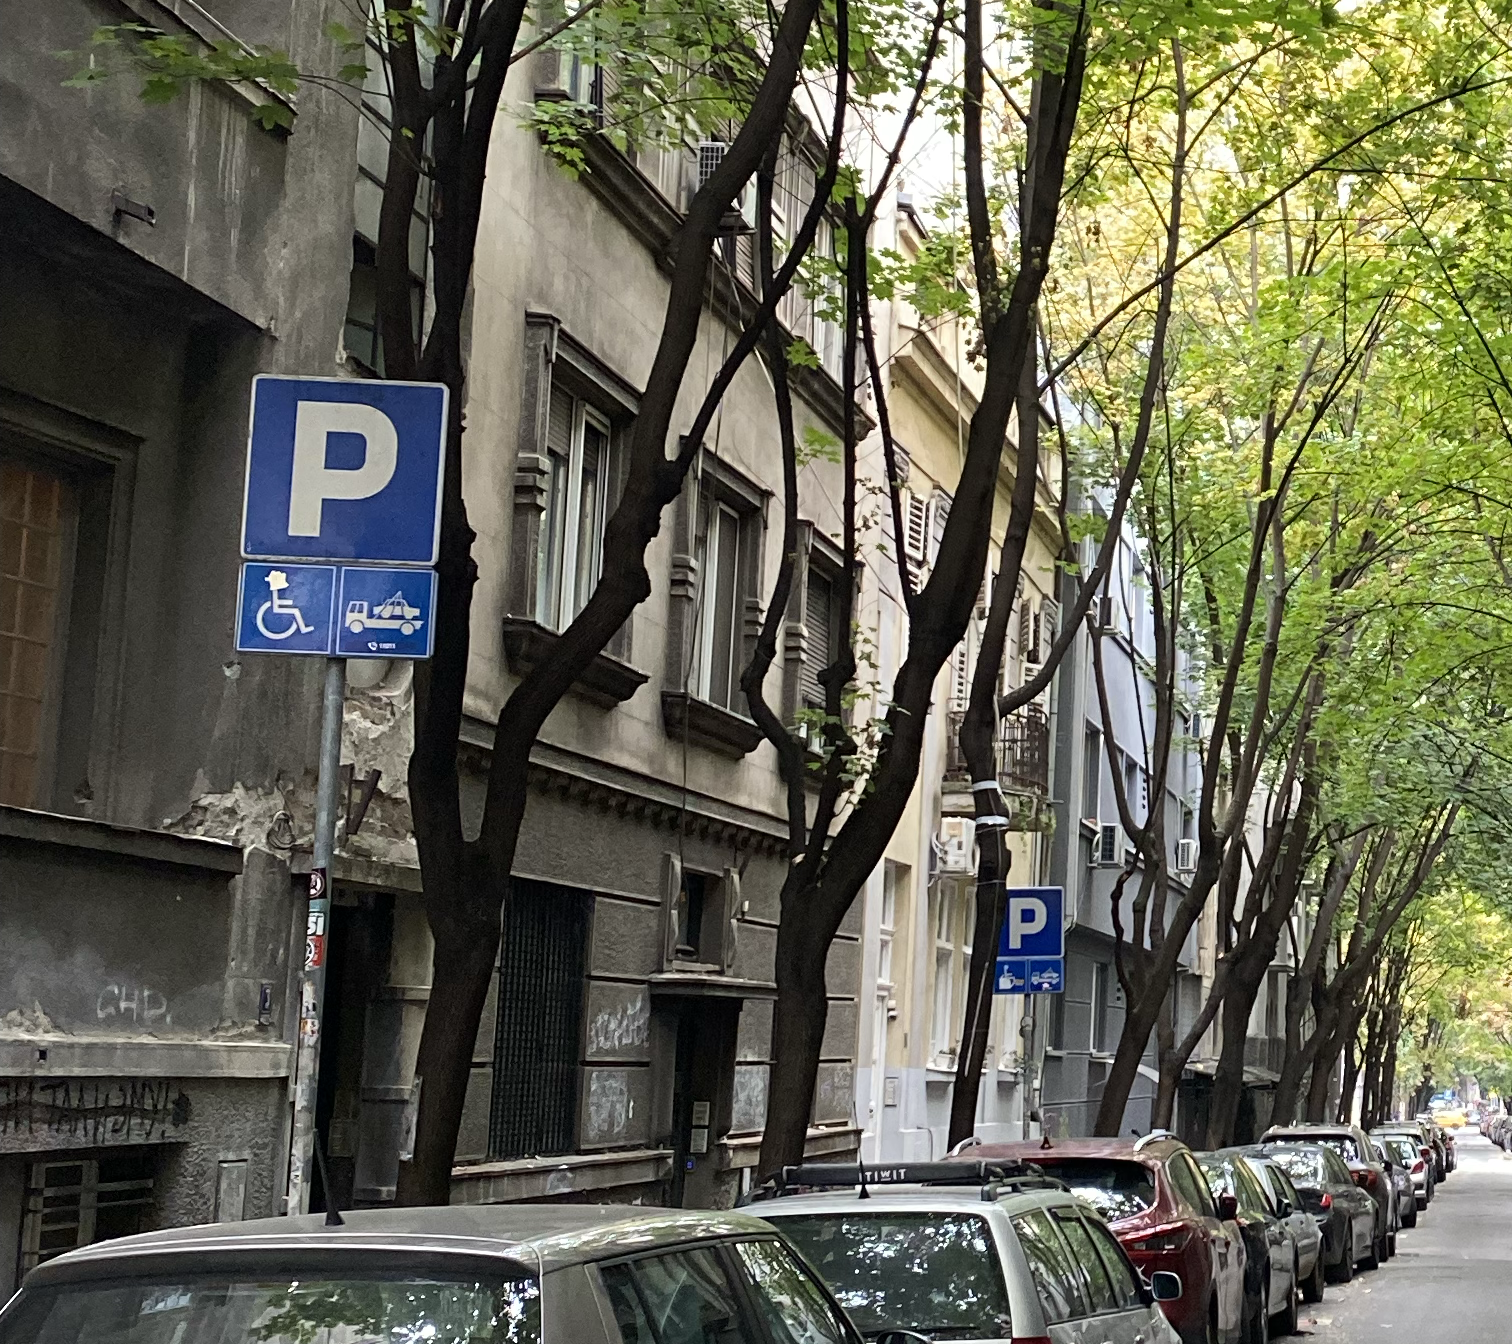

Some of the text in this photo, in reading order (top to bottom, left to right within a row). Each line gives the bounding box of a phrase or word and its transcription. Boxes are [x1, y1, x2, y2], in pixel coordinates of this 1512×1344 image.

[288, 400, 398, 537] P
[1009, 897, 1048, 950] P
[859, 1169, 906, 1182] ITIWIT
